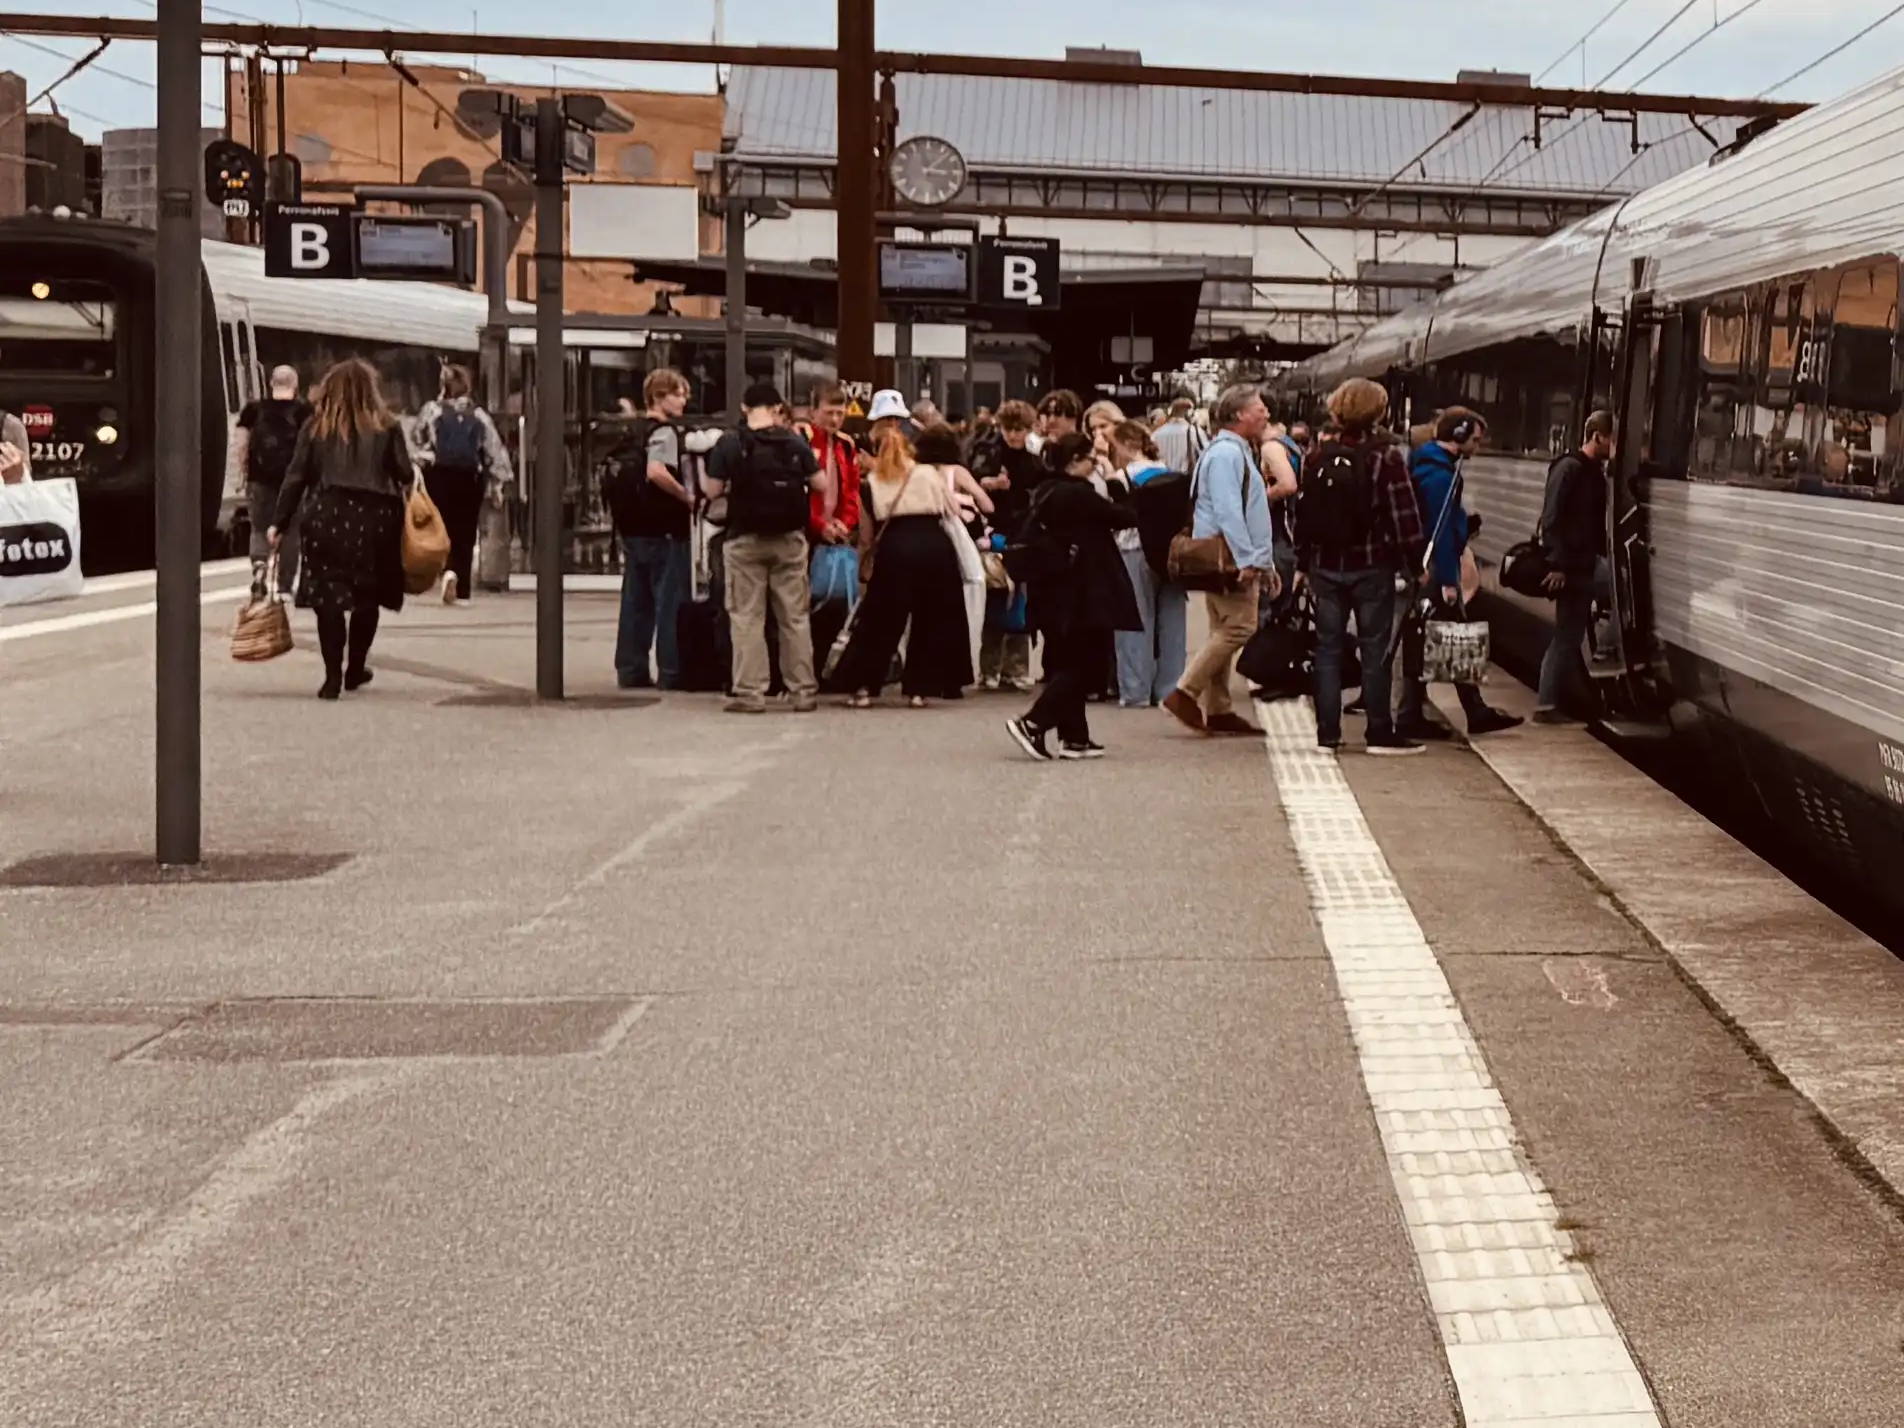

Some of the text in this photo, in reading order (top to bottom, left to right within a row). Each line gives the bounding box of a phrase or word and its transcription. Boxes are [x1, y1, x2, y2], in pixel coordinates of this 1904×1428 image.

[291, 223, 330, 269] B
[1003, 255, 1039, 300] B
[32, 442, 84, 461] 2107
